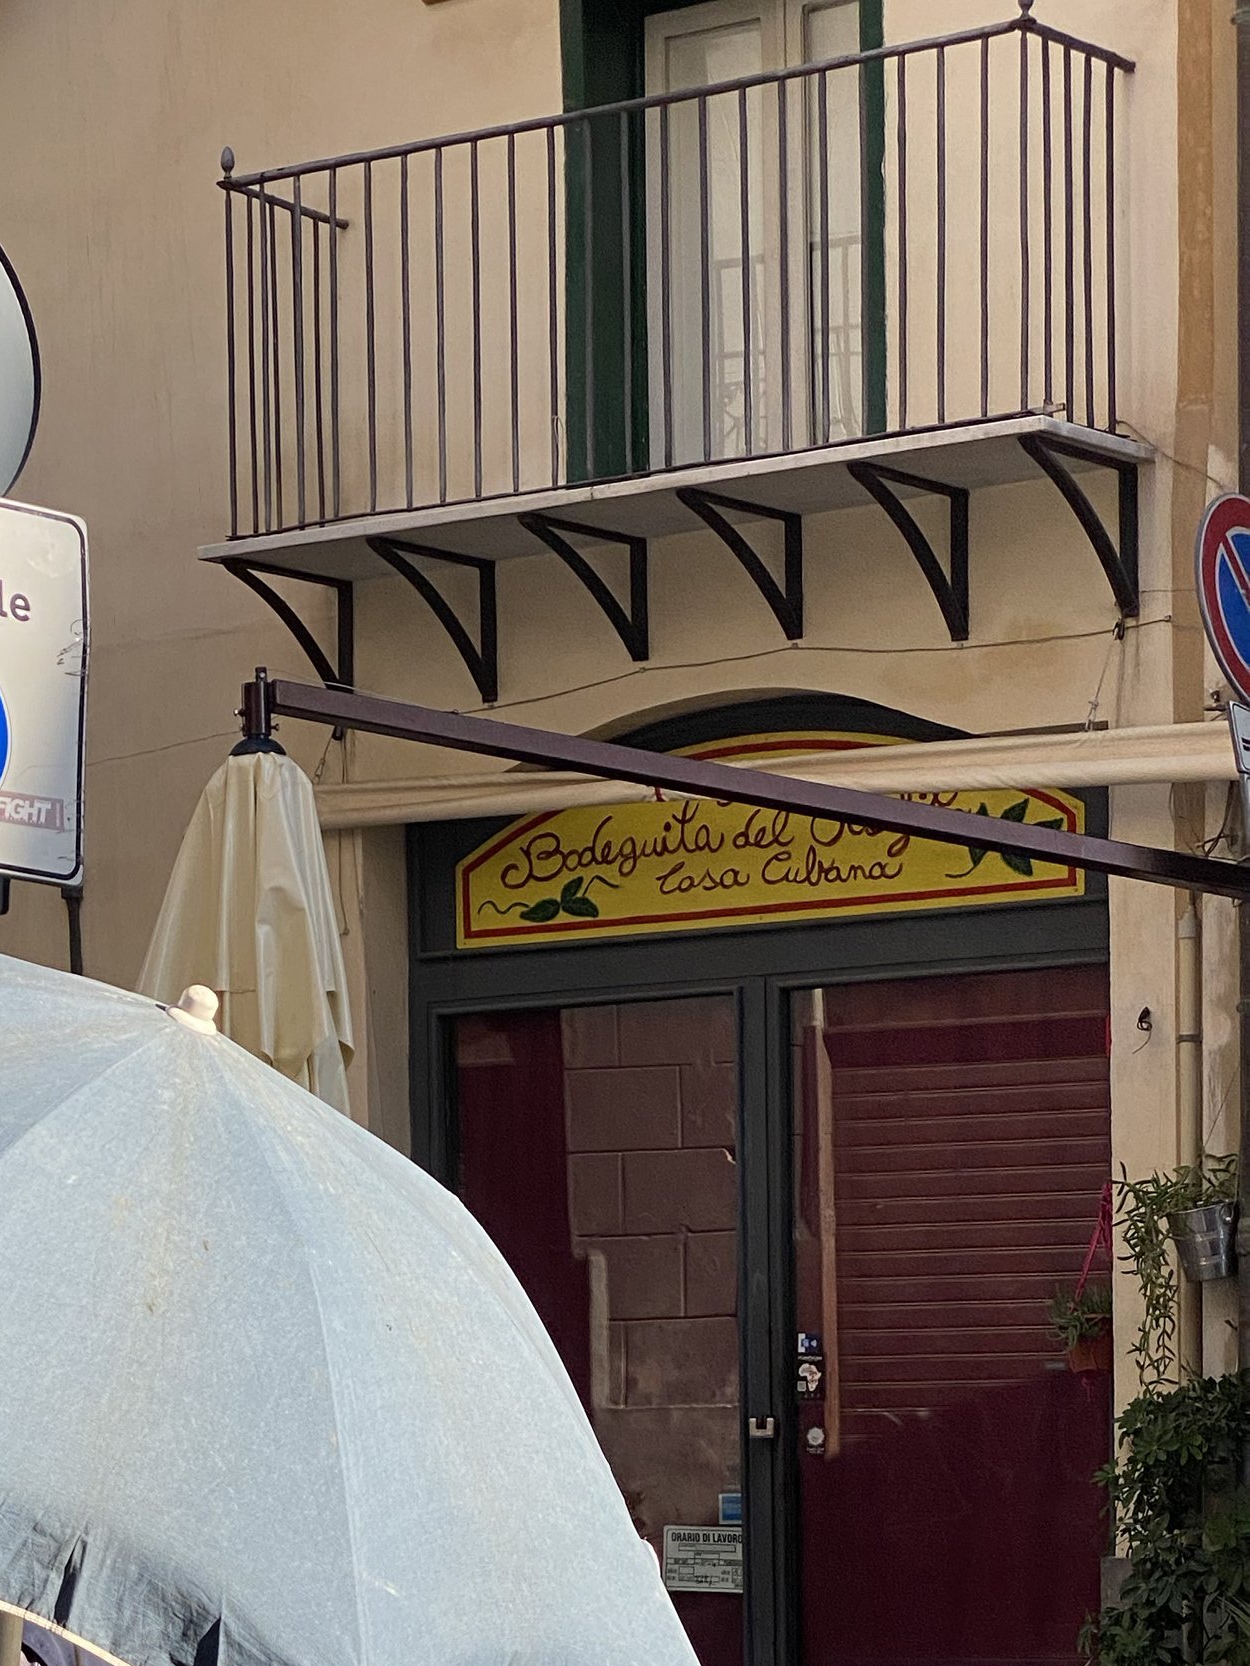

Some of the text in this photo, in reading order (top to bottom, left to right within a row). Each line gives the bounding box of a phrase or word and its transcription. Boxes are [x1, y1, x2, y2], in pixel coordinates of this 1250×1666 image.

[500, 800, 724, 889] Bodeguita
[732, 808, 794, 850] del
[761, 844, 903, 887] Cubana
[671, 1532, 742, 1544] ORARIO DI LAVORO
